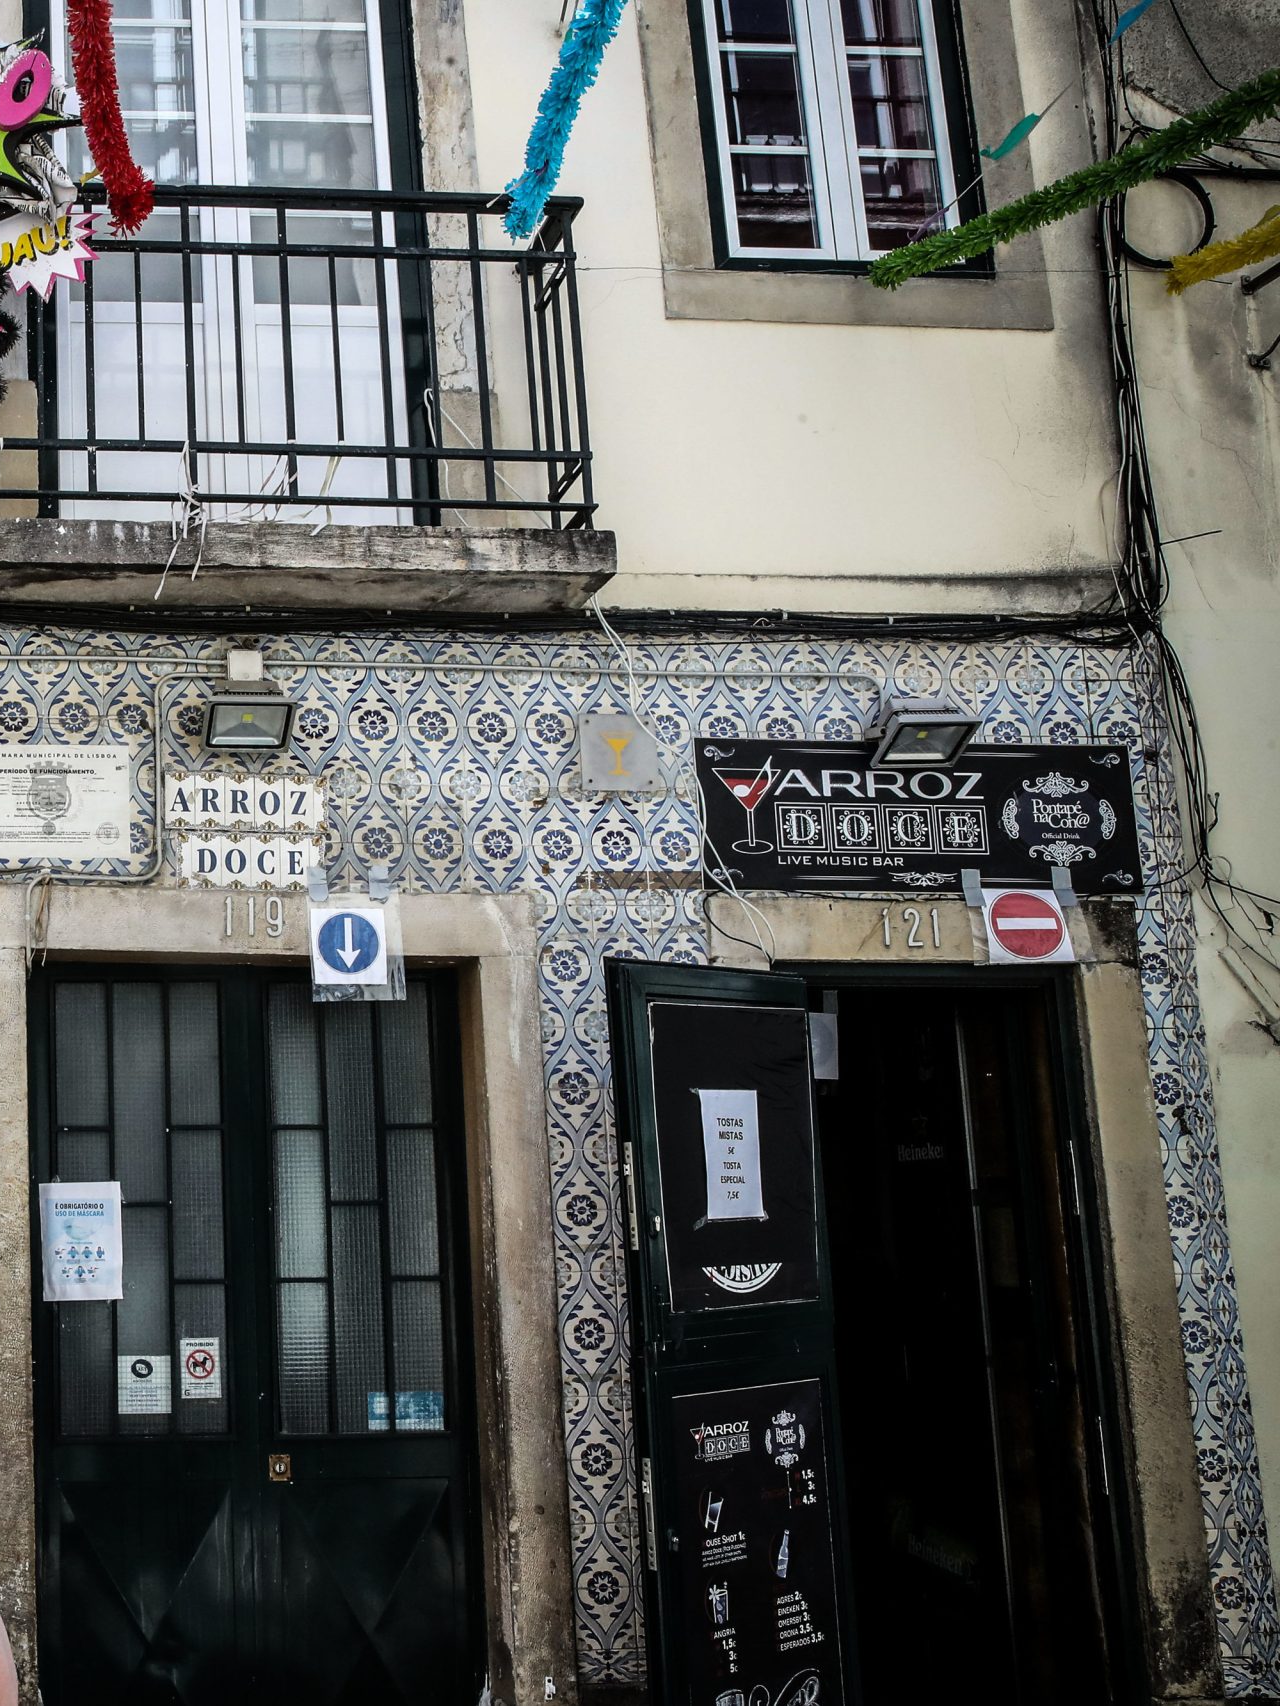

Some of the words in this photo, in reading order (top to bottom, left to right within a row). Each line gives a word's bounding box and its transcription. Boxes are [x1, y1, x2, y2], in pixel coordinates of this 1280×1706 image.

[774, 770, 984, 799] ARROZ
[170, 788, 307, 816] ARROZ
[1031, 799, 1082, 817] Pontapé
[782, 808, 982, 848] DOCE
[1041, 832, 1060, 840] Official
[1061, 832, 1080, 840] Drink
[198, 849, 304, 875] DOCE
[777, 855, 812, 866] LIVE
[816, 856, 868, 866] MUSIC
[873, 856, 904, 867] BAR
[225, 896, 283, 937] 119
[882, 907, 940, 948] 121
[717, 1117, 743, 1127] TOSTAS
[719, 1131, 743, 1140] MISTAS
[723, 1162, 741, 1170] TOSTA
[720, 1176, 745, 1184] ESPECIAL
[727, 1191, 739, 1200] 7,5€
[60, 1202, 98, 1210] OBRIGATÓRIO
[704, 1420, 749, 1438] ARROZ
[722, 1534, 738, 1544] SHOT
